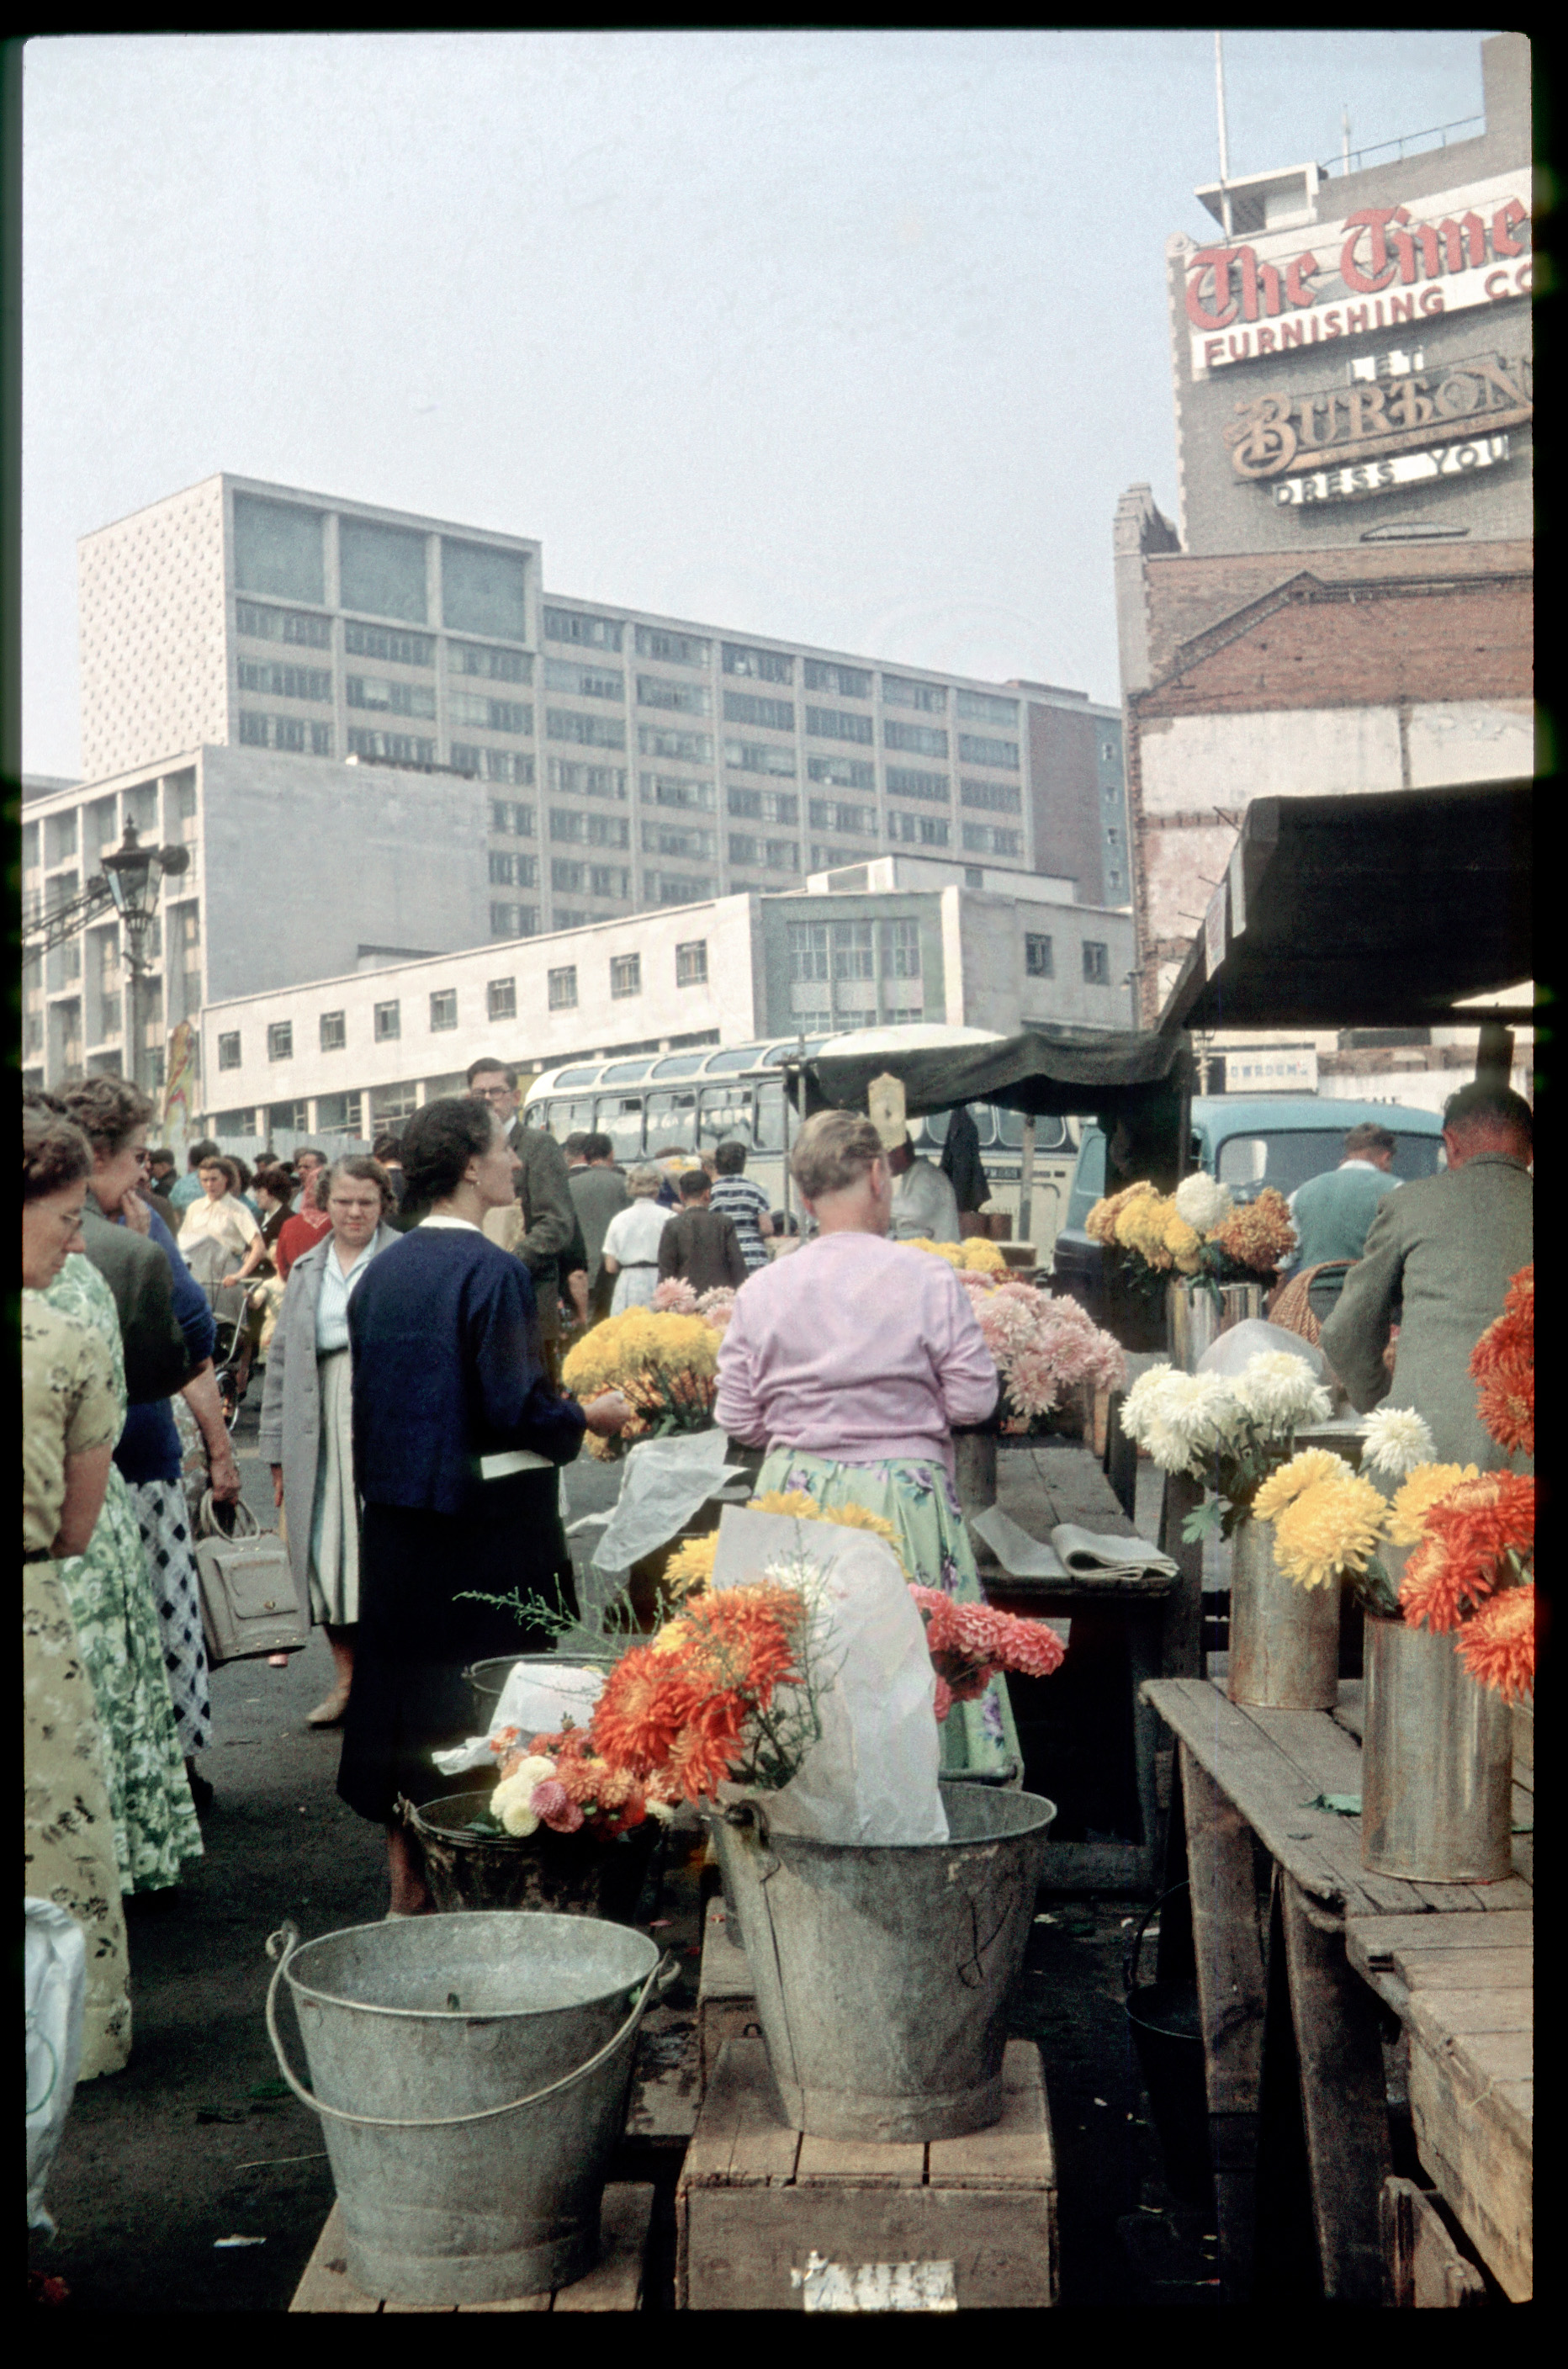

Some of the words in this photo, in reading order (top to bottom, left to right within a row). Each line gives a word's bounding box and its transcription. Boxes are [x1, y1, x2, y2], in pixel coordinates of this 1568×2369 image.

[1184, 244, 1320, 331] The
[1340, 197, 1528, 294] Time
[1204, 284, 1447, 368] FURNISHING
[1348, 345, 1426, 385] LET
[1221, 356, 1534, 480] BURTON
[1272, 460, 1397, 506] DRESS
[1428, 434, 1511, 478] YOU
